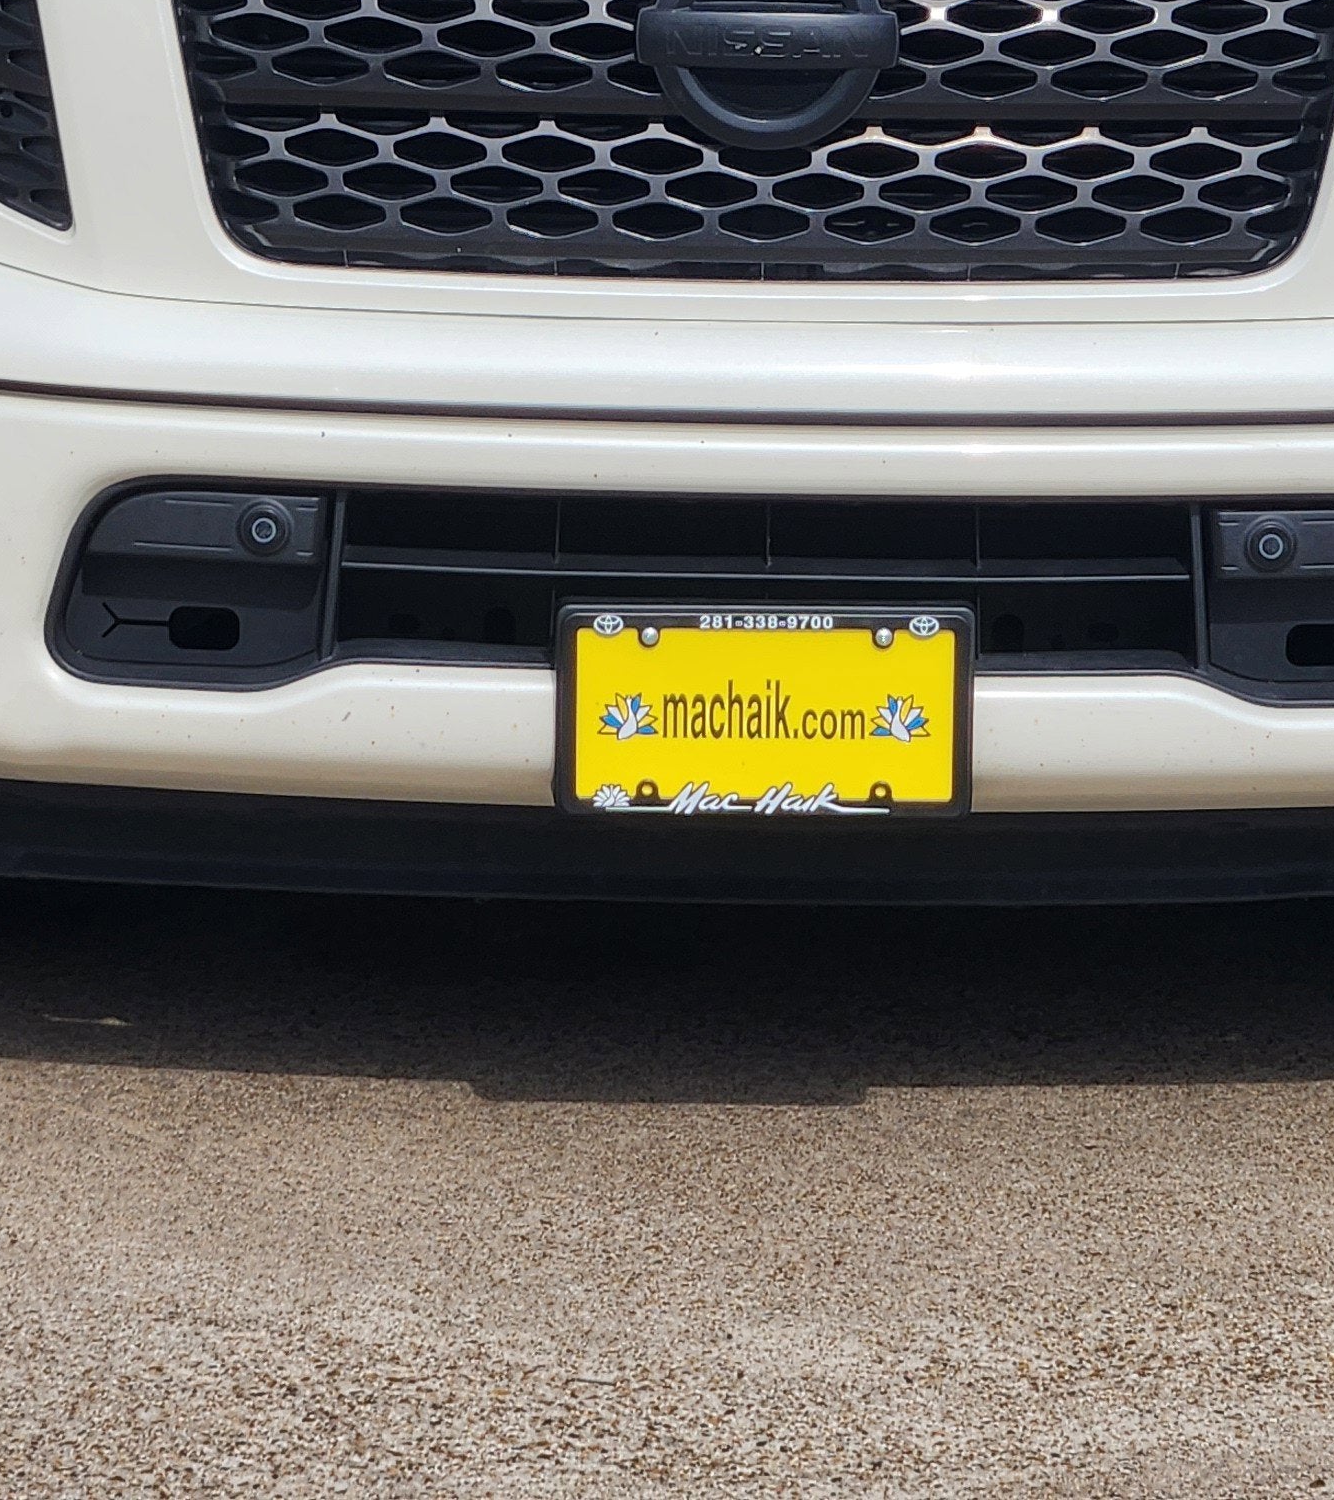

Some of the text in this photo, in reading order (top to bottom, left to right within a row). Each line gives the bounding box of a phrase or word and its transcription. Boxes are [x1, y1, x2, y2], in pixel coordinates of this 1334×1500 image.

[699, 614, 834, 630] 281-338-9700
[661, 678, 867, 741] machaik.com
[668, 780, 843, 815] Mac Haik
